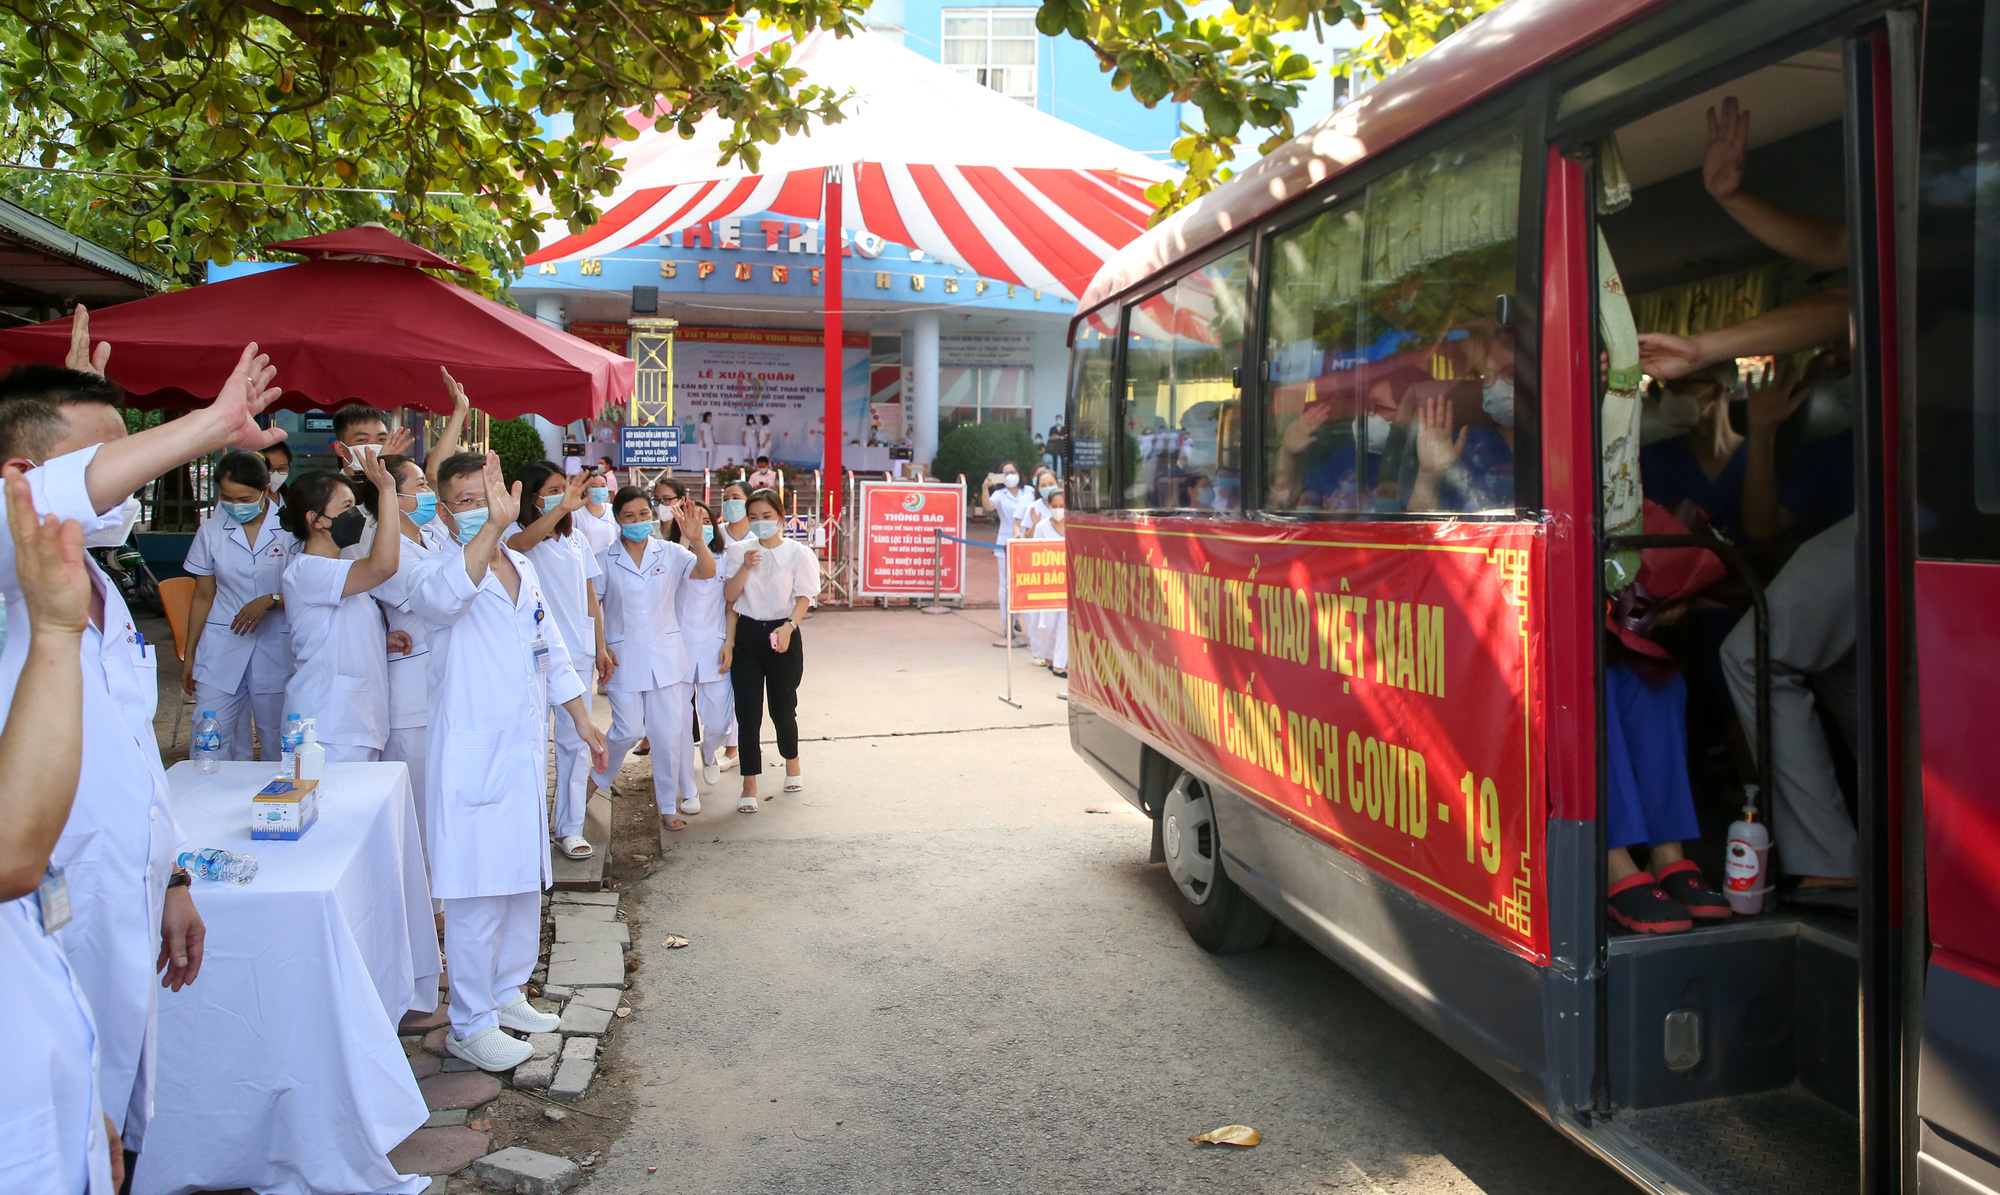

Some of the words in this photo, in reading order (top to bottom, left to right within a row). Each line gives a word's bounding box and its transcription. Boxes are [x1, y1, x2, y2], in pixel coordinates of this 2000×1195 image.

[660, 259, 824, 286] SPORT
[707, 331, 729, 340] NAM
[731, 331, 763, 342] QUANG
[765, 333, 787, 343] VINH
[698, 368, 714, 379] LỄ
[718, 369, 754, 380] XUẤT
[757, 371, 795, 382] QUÂN
[884, 512, 920, 522] THÔNG
[922, 513, 945, 523] BÁO
[1016, 572, 1041, 586] KHAI
[1043, 569, 1065, 585] BÁO
[1130, 564, 1137, 617] Y
[1137, 547, 1154, 622] TẾ
[1153, 556, 1186, 640] BỆNH
[1188, 561, 1221, 654] VIỆN
[1223, 553, 1261, 651] THỂ
[1257, 585, 1311, 666] THAO
[1314, 576, 1369, 695] VIỆT
[1376, 599, 1445, 699] NAM
[1181, 670, 1221, 748] MINH
[1223, 672, 1285, 780] CHỐNG
[1287, 708, 1341, 808] DỊCH
[1346, 730, 1428, 841] COVID
[1459, 770, 1502, 876] 19
